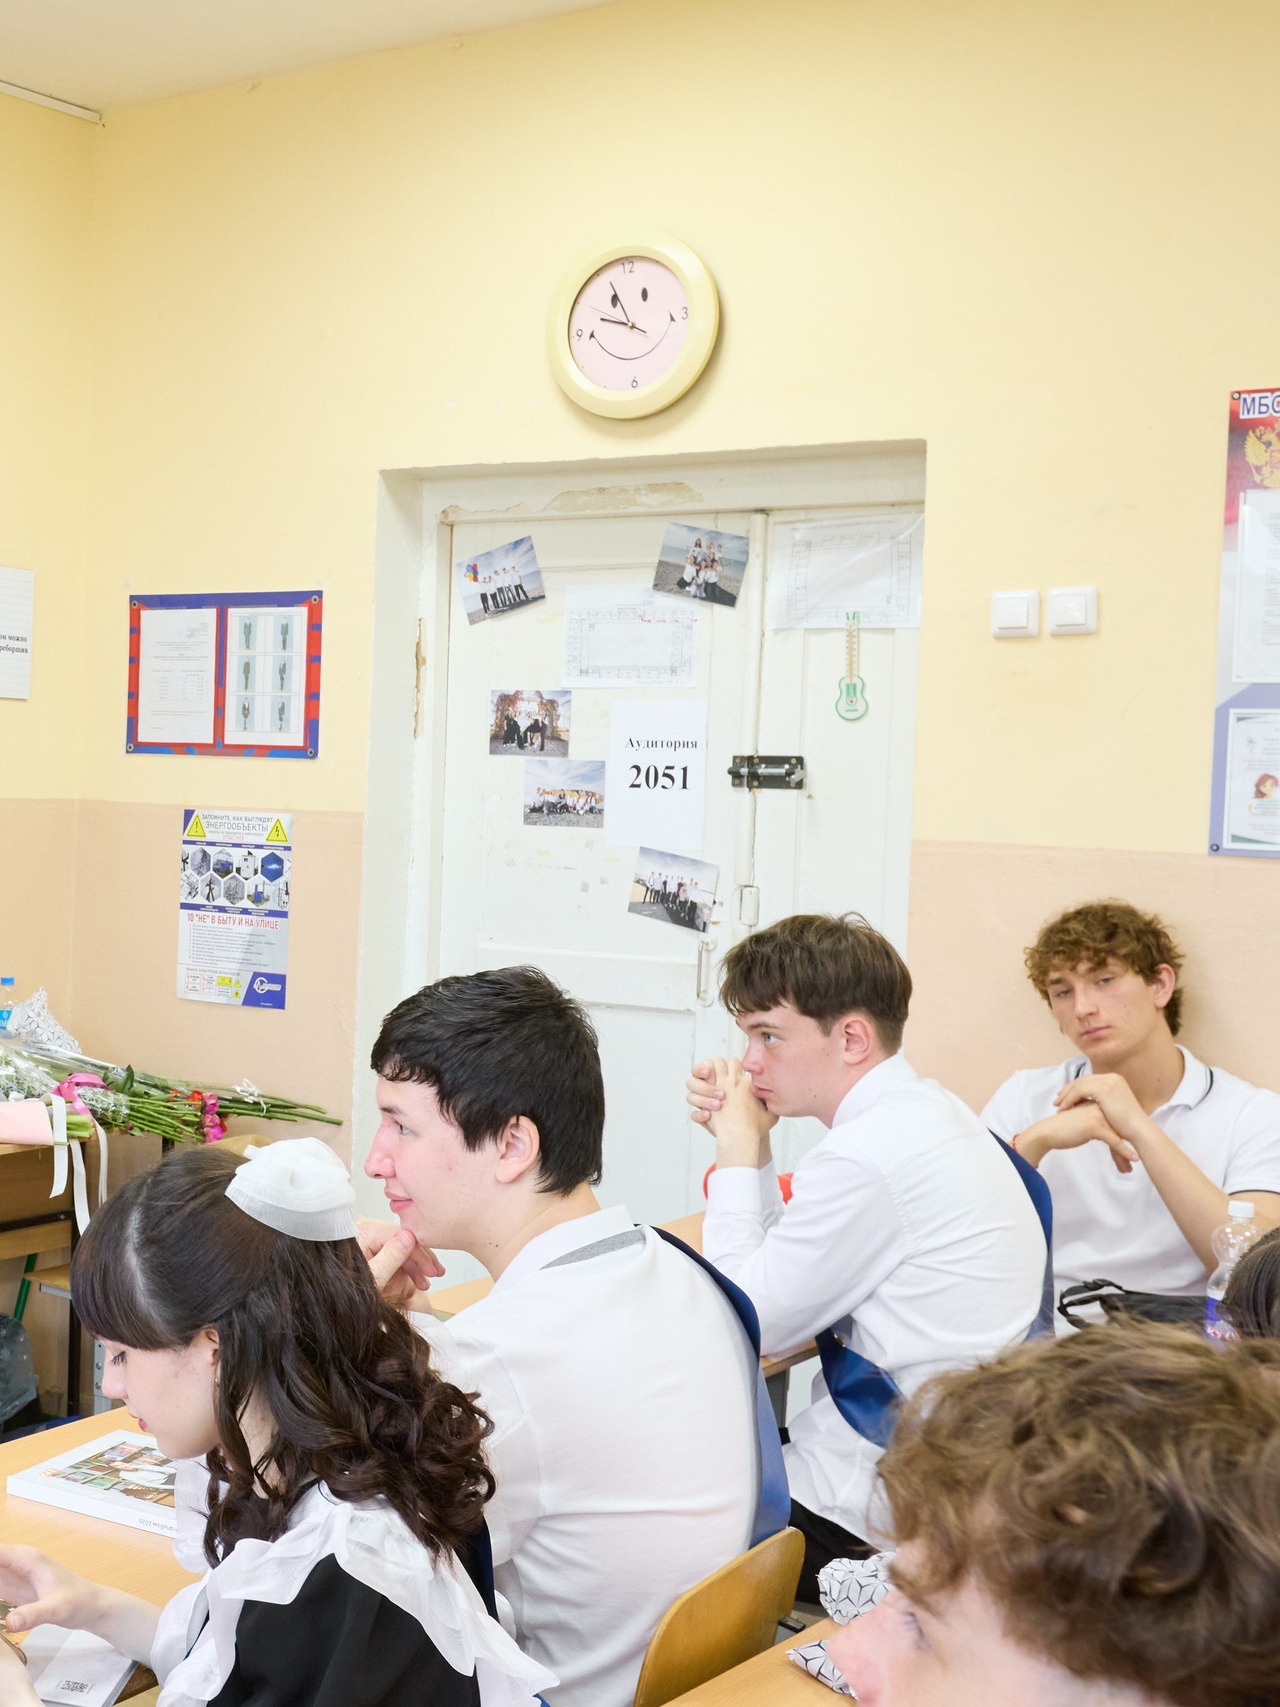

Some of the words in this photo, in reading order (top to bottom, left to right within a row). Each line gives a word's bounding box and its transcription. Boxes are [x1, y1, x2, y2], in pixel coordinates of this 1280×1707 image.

[621, 260, 635, 274] 12
[681, 306, 689, 320] 3
[576, 328, 584, 342] 9
[631, 375, 639, 389] 6
[8, 635, 28, 643] можно
[625, 737, 698, 752] Аудитория
[628, 764, 691, 790] 2051
[201, 813, 231, 822] ЗАПОМНИТЕ,
[205, 821, 269, 832] ЭНЕРГООБЪЕКТЫ
[187, 913, 195, 922] 10
[195, 913, 210, 924] "НЕ"
[217, 915, 237, 925] БЫТУ
[244, 918, 254, 927] НА
[255, 919, 279, 930] УЛИЦЕ
